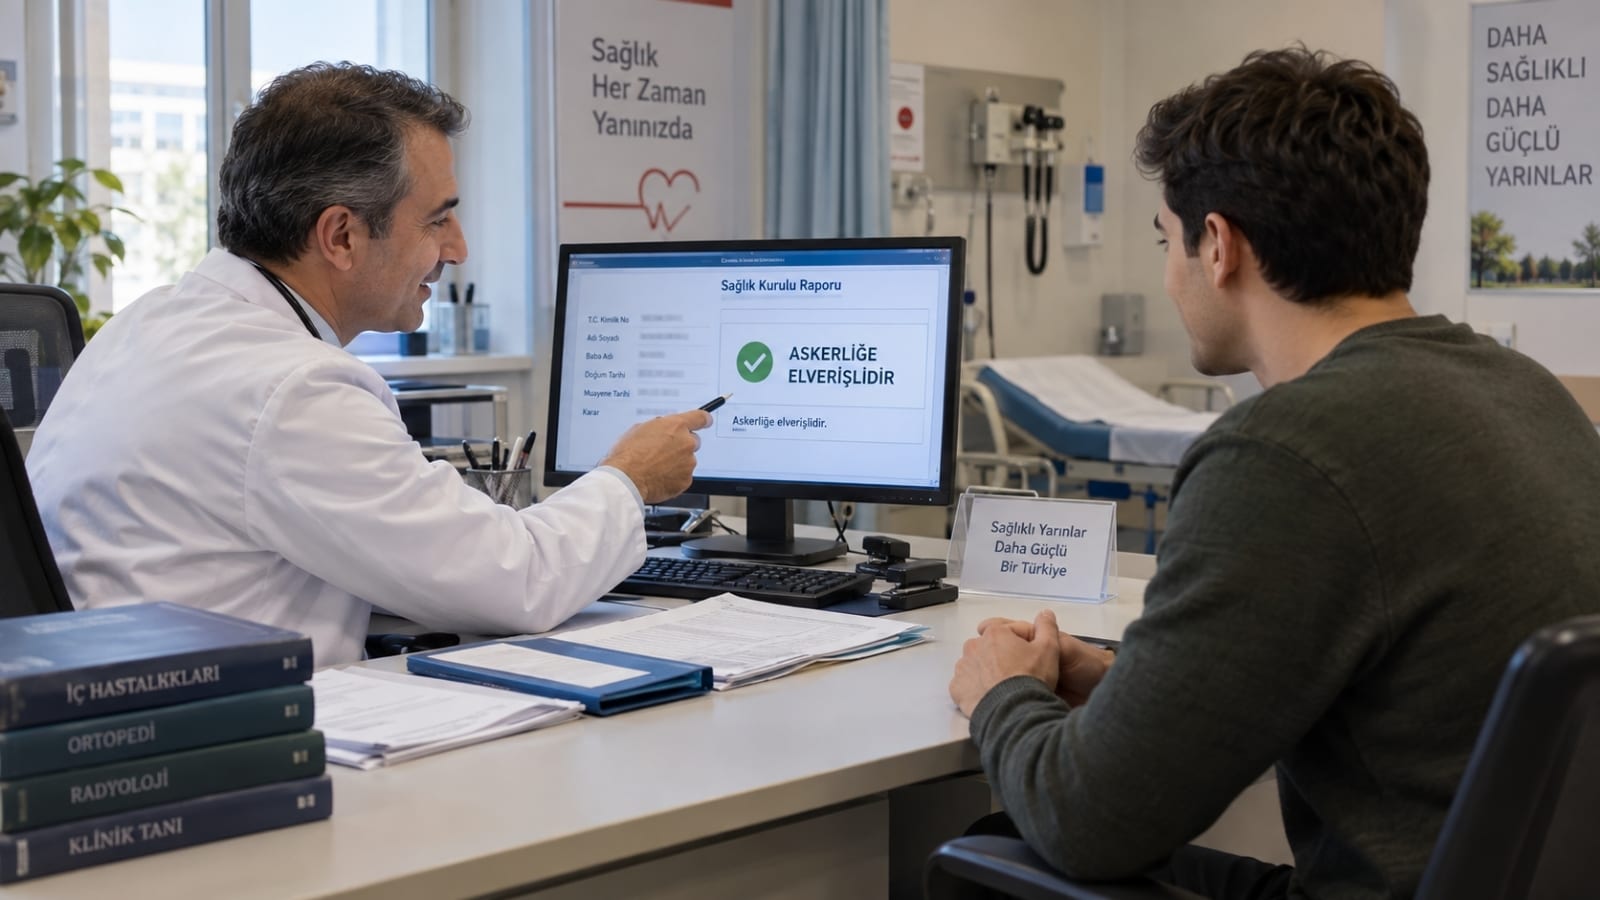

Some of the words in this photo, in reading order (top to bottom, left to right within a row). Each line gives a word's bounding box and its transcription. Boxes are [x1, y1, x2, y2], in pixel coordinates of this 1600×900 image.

[1487, 24, 1547, 49] DAHA
[591, 37, 659, 71] Sağlık
[1486, 55, 1586, 84] SAĞLIKLI
[592, 73, 631, 100] Her
[637, 77, 706, 106] Zaman
[1486, 95, 1546, 119] DAHA
[592, 110, 693, 140] Yanınızda
[1486, 125, 1560, 157] GÜÇLÜ
[1486, 164, 1593, 188] YARINLAR
[721, 279, 756, 294] Sağlık
[759, 279, 796, 291] Kurulu
[800, 279, 842, 293] Raporu
[789, 344, 877, 361] ASKERLİĞE
[788, 366, 895, 388] ELVERİŞLİDİR
[732, 415, 775, 429] Askerliğe
[777, 416, 828, 430] elverişlidir.
[990, 520, 1036, 537] Sağlıklı
[1038, 523, 1088, 538] Yarınlar
[994, 540, 1027, 555] Daha
[1030, 543, 1068, 559] Güçlü
[1000, 560, 1019, 573] Bir
[1021, 561, 1068, 579] Türkiye
[68, 721, 156, 755] ORTOPEDİ
[70, 767, 169, 804] RADYOLOJİ
[69, 825, 134, 856] KLİNİK
[139, 817, 183, 841] TANI
